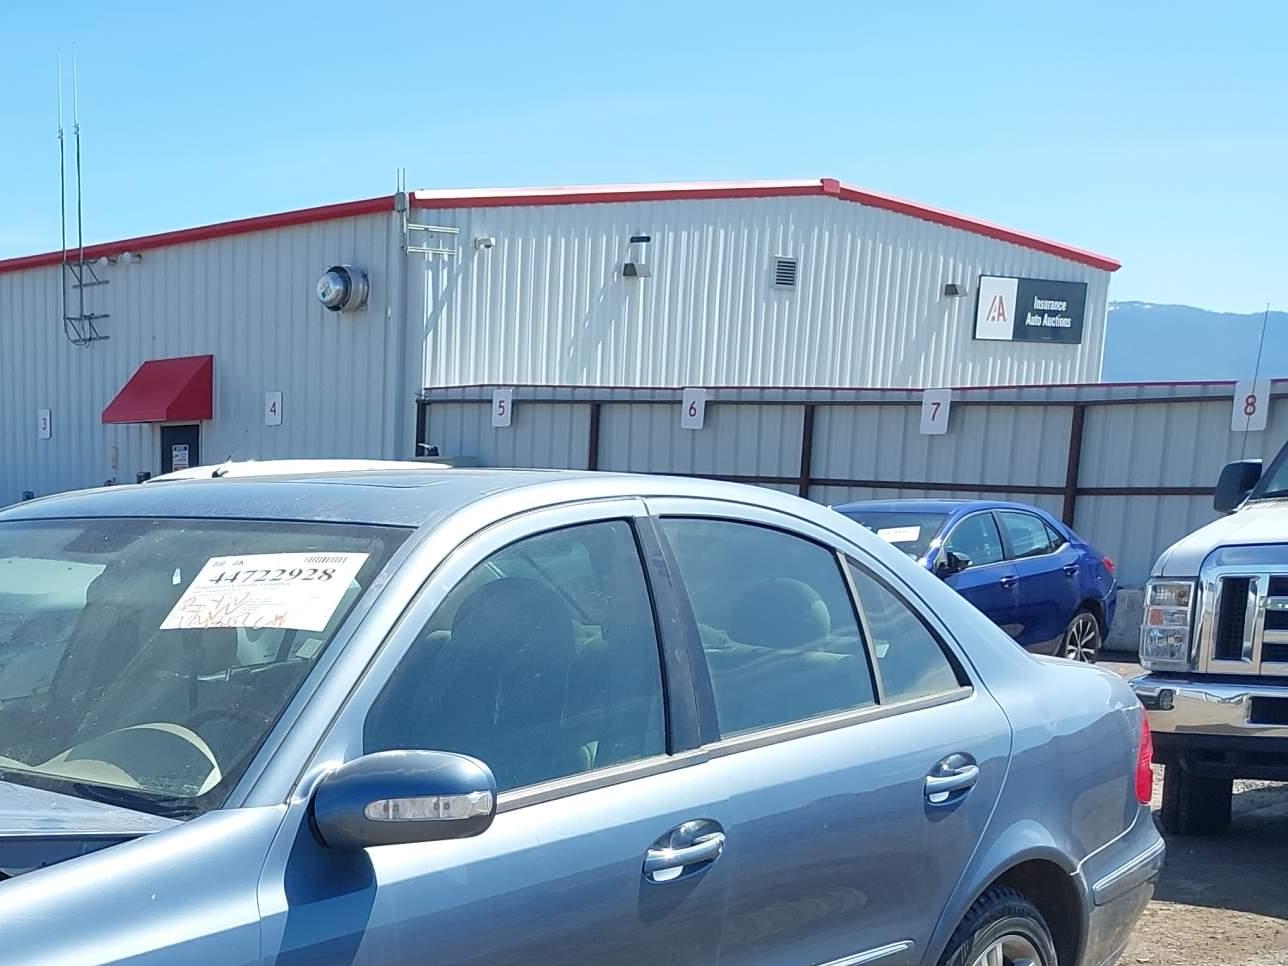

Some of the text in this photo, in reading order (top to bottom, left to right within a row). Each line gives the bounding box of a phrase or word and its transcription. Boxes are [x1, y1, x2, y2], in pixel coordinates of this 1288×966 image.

[1033, 296, 1067, 311] Insurance
[1025, 312, 1072, 328] Auto Auctions
[269, 401, 277, 416] 4
[497, 400, 505, 416] 5
[688, 400, 697, 417] 6
[931, 402, 941, 421] 7
[1244, 395, 1257, 416] 8
[41, 417, 47, 431] 3
[209, 568, 336, 585] 44722928
